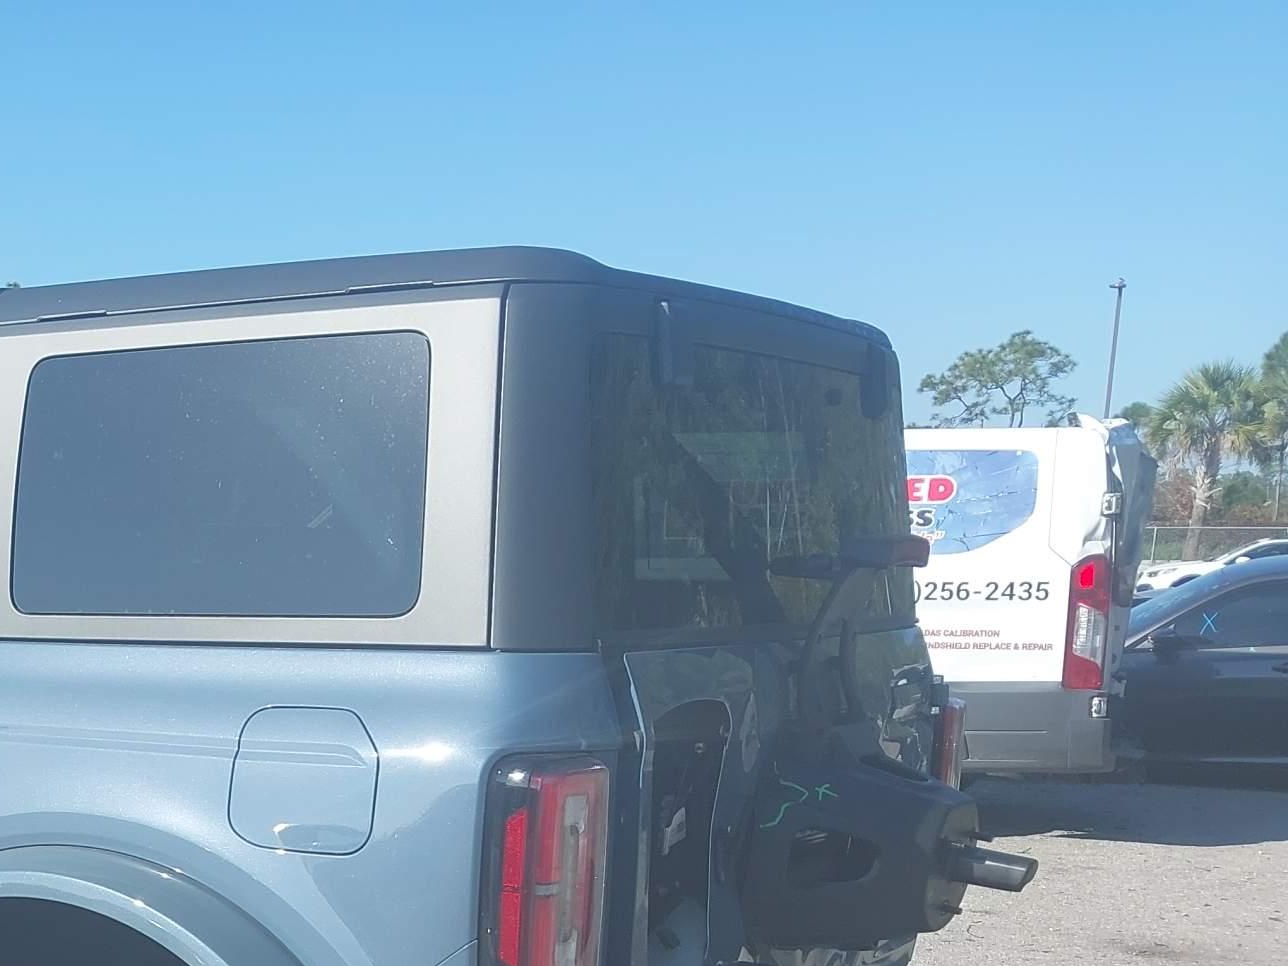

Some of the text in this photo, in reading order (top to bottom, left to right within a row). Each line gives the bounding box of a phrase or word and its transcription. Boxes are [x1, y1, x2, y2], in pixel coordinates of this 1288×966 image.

[909, 509, 934, 527] S
[943, 629, 1000, 638] CALIBRATION
[926, 641, 970, 650] NDSHIELD
[972, 642, 1012, 650] REPLACE
[1022, 643, 1054, 651] REPAIR
